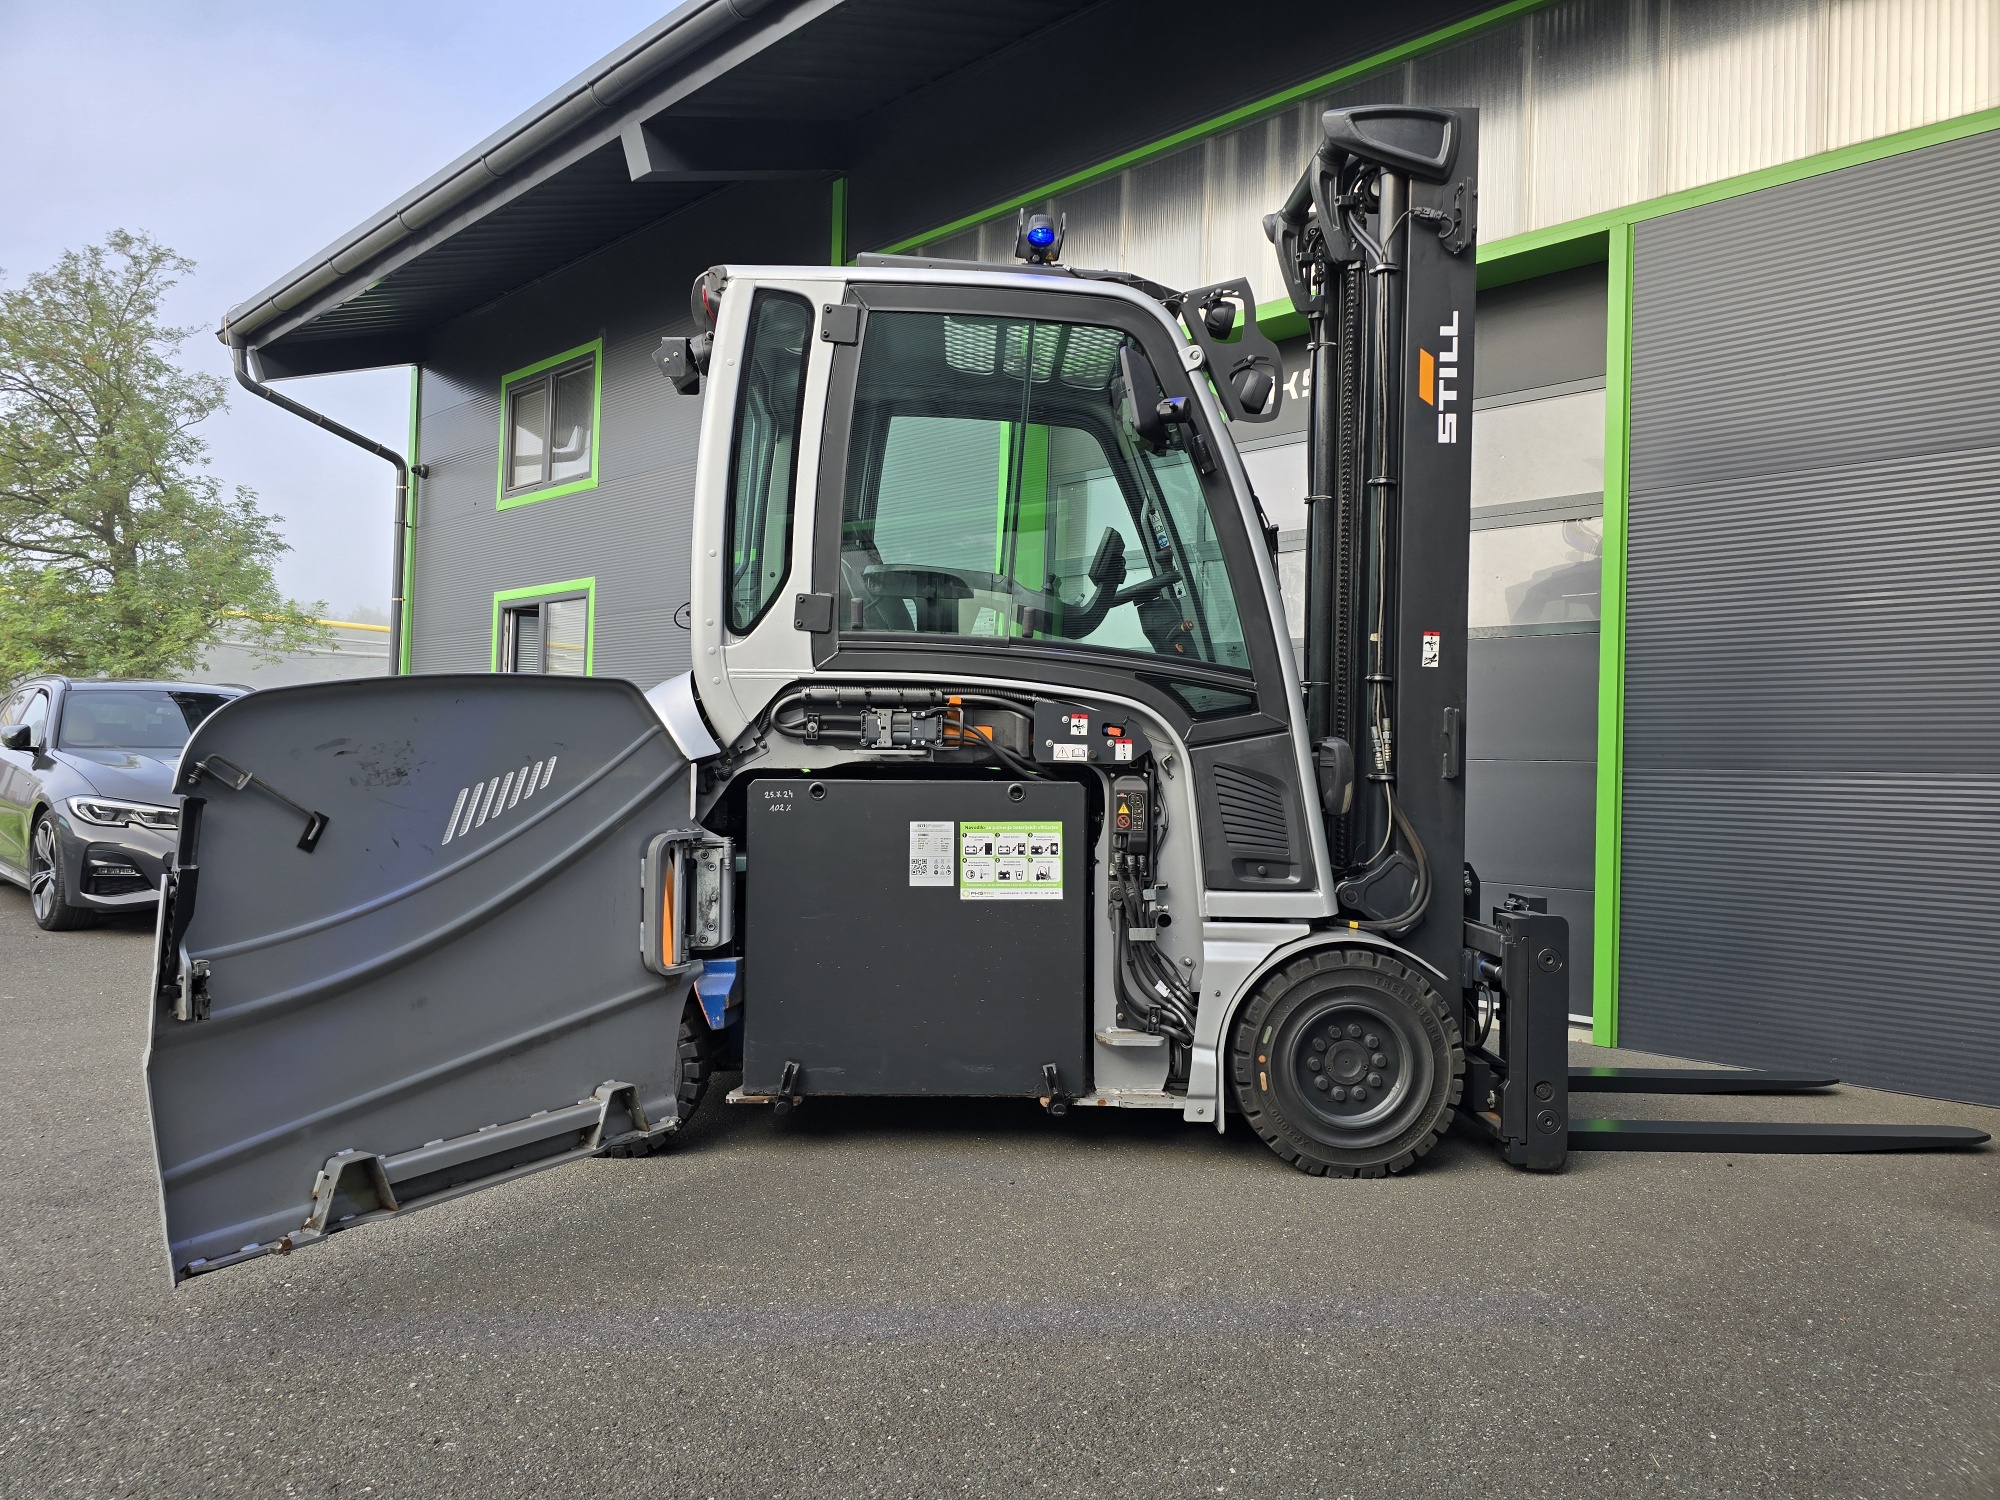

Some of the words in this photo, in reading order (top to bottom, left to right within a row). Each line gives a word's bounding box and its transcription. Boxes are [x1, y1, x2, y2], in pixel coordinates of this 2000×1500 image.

[1437, 310, 1459, 444] STILL
[769, 804, 784, 812] 102
[1375, 975, 1441, 1042] TRELLEBORG
